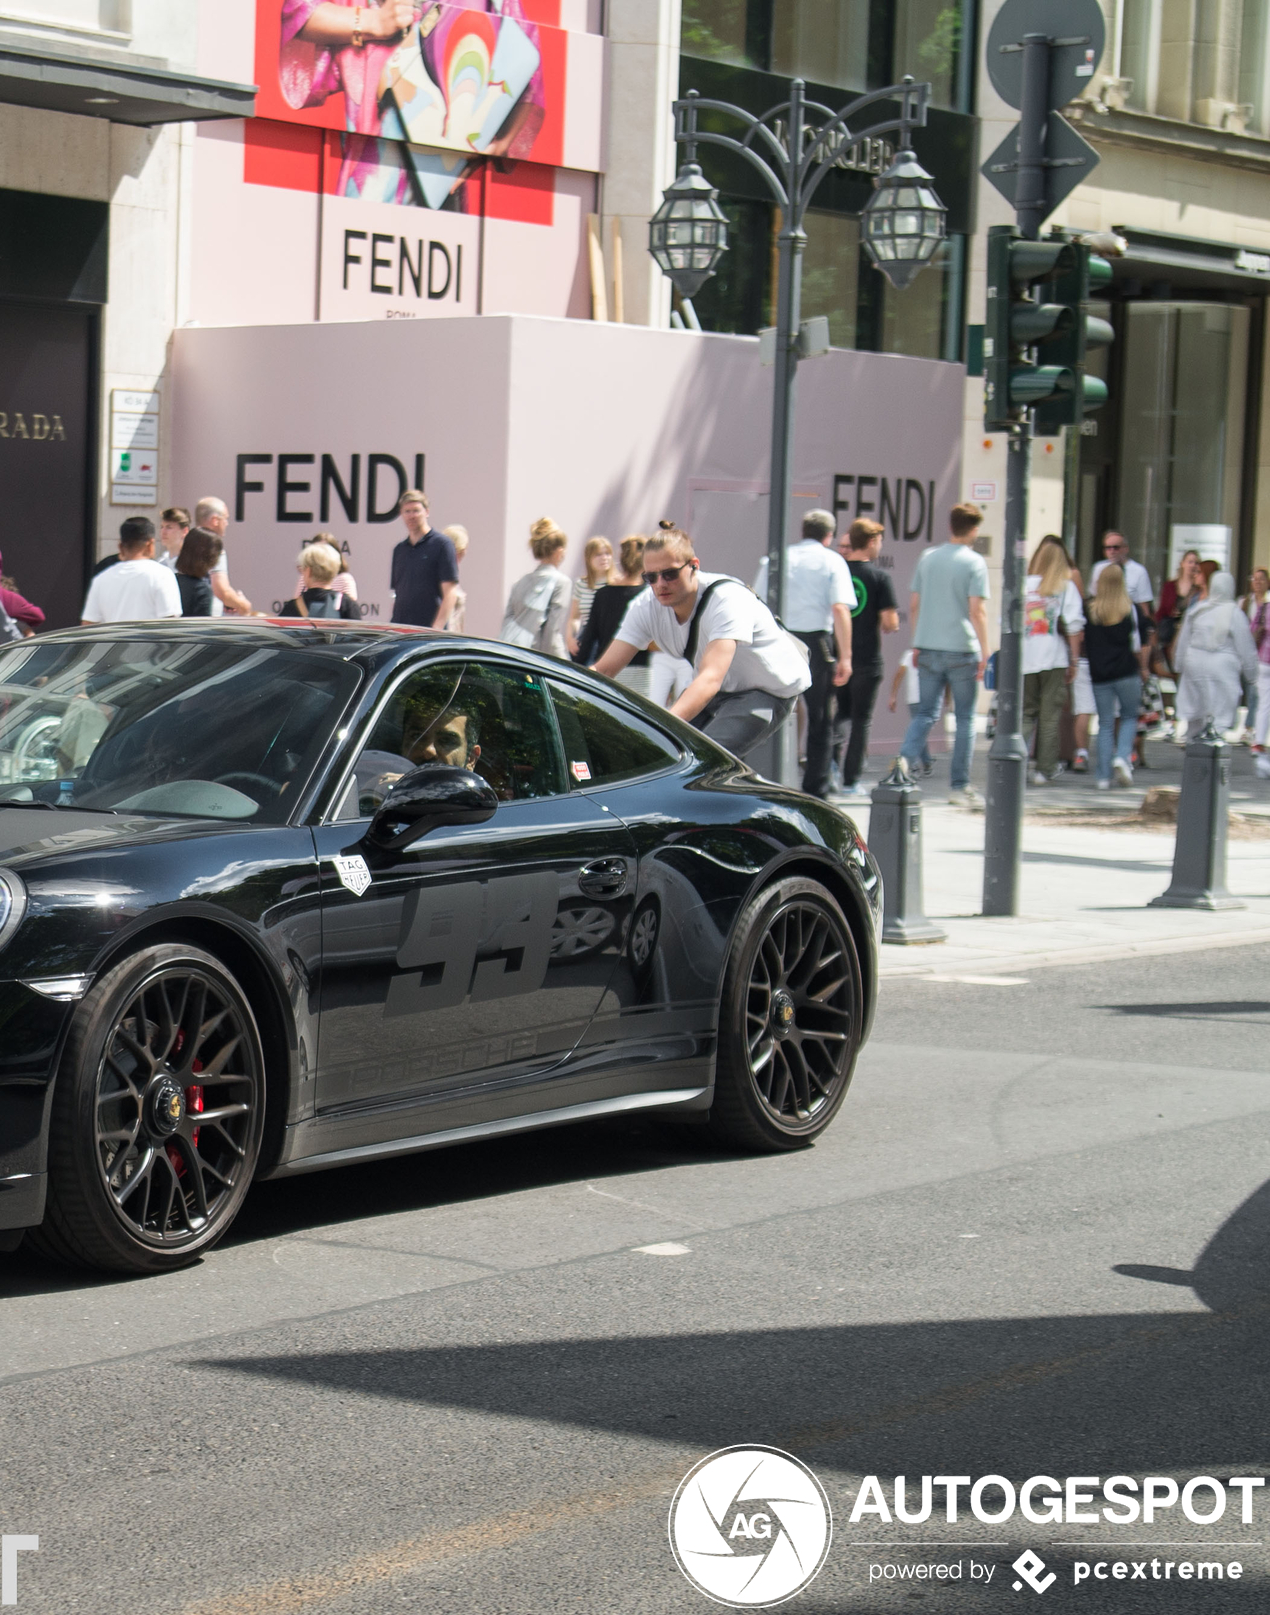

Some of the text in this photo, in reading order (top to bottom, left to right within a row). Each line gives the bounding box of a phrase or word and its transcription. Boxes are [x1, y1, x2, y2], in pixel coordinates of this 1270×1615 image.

[343, 229, 462, 303] FENDI
[235, 453, 426, 524] FENDI
[832, 474, 936, 543] FENDI
[339, 859, 364, 871] TAG
[343, 872, 368, 891] HEUER
[383, 871, 561, 1018] 93
